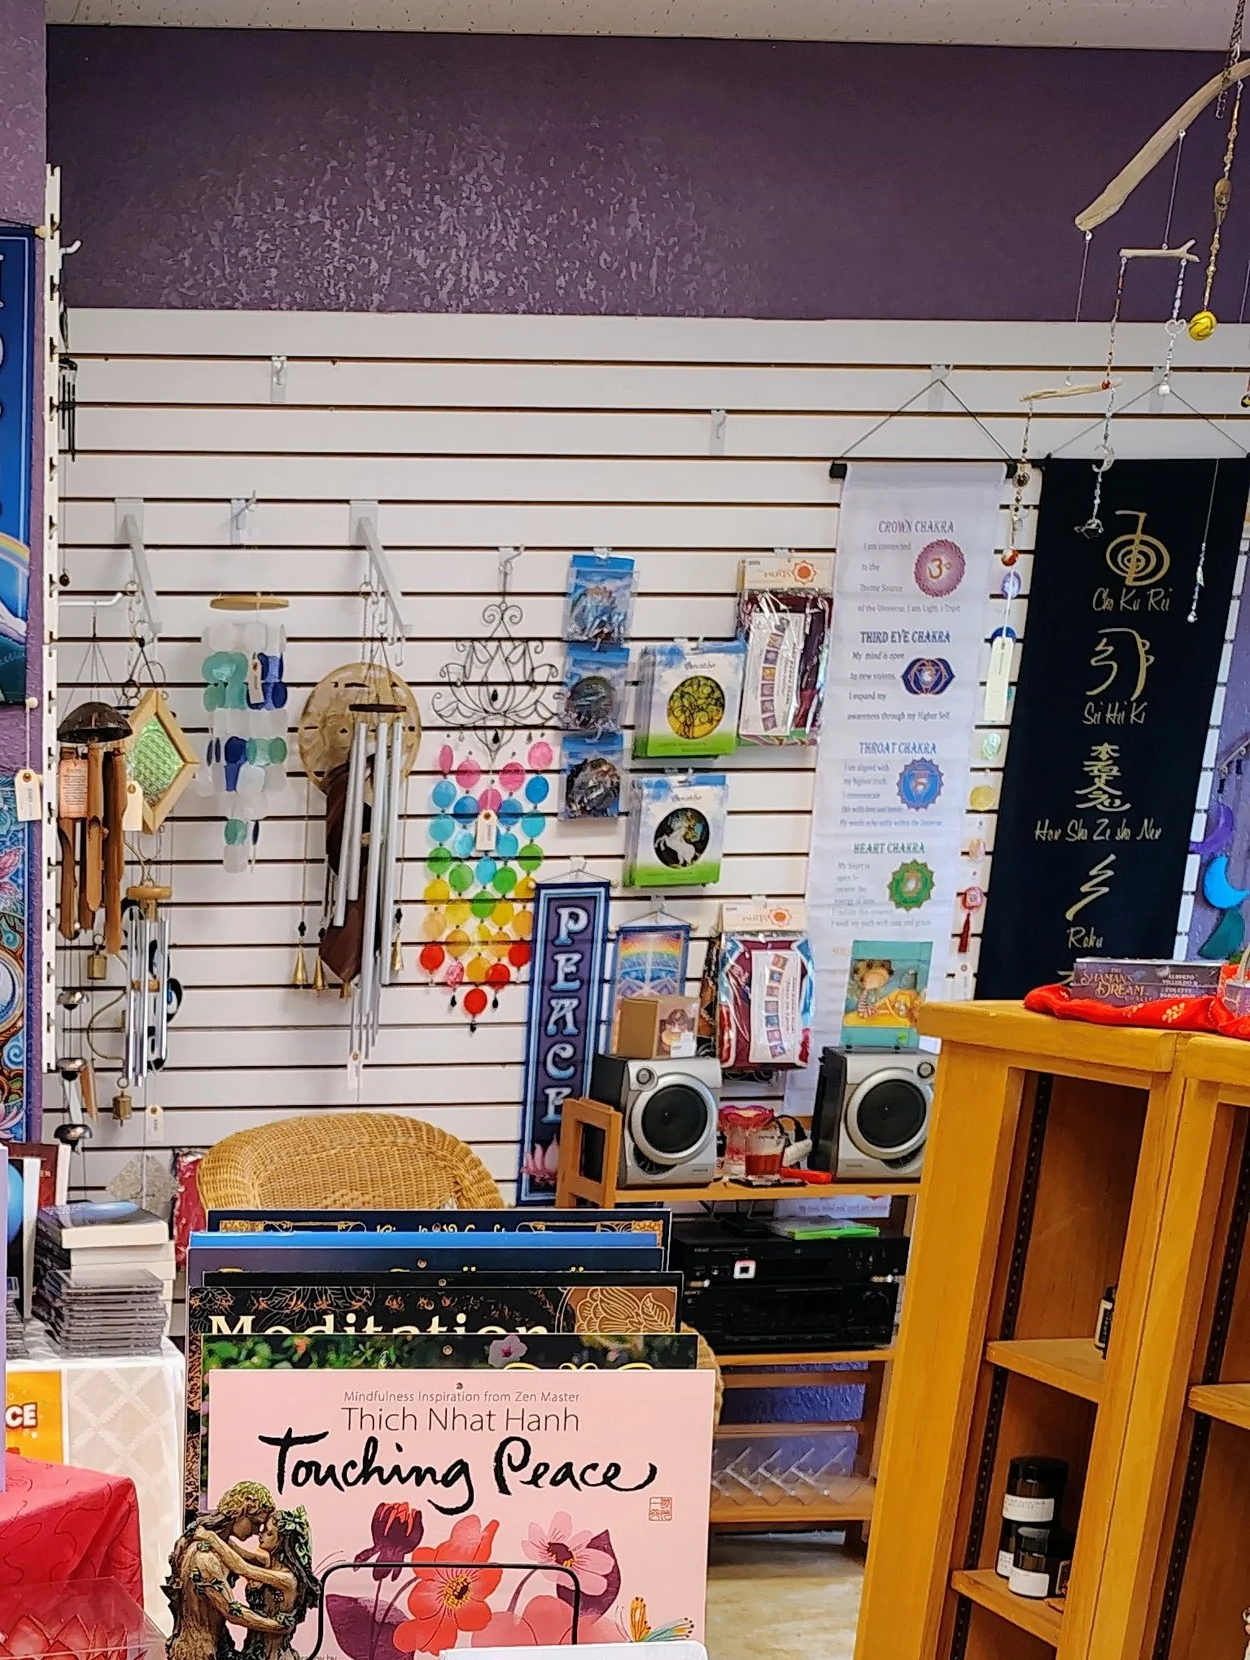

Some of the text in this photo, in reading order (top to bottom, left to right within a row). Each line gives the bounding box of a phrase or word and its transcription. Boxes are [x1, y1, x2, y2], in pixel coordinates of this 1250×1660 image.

[878, 520, 954, 533] CROWN CHAKRA
[860, 631, 888, 643] THIRD
[912, 630, 950, 643] CHAKRA
[859, 742, 938, 754] THROAT CHAKRA
[854, 843, 925, 854] HEART CHAKRA
[539, 906, 589, 1124] PEACE
[343, 1391, 581, 1405] Mindfulness Inspiration from Zen Master
[341, 1406, 580, 1432] Thich Nhat Hanh
[258, 1427, 658, 1516] Touching Peace
